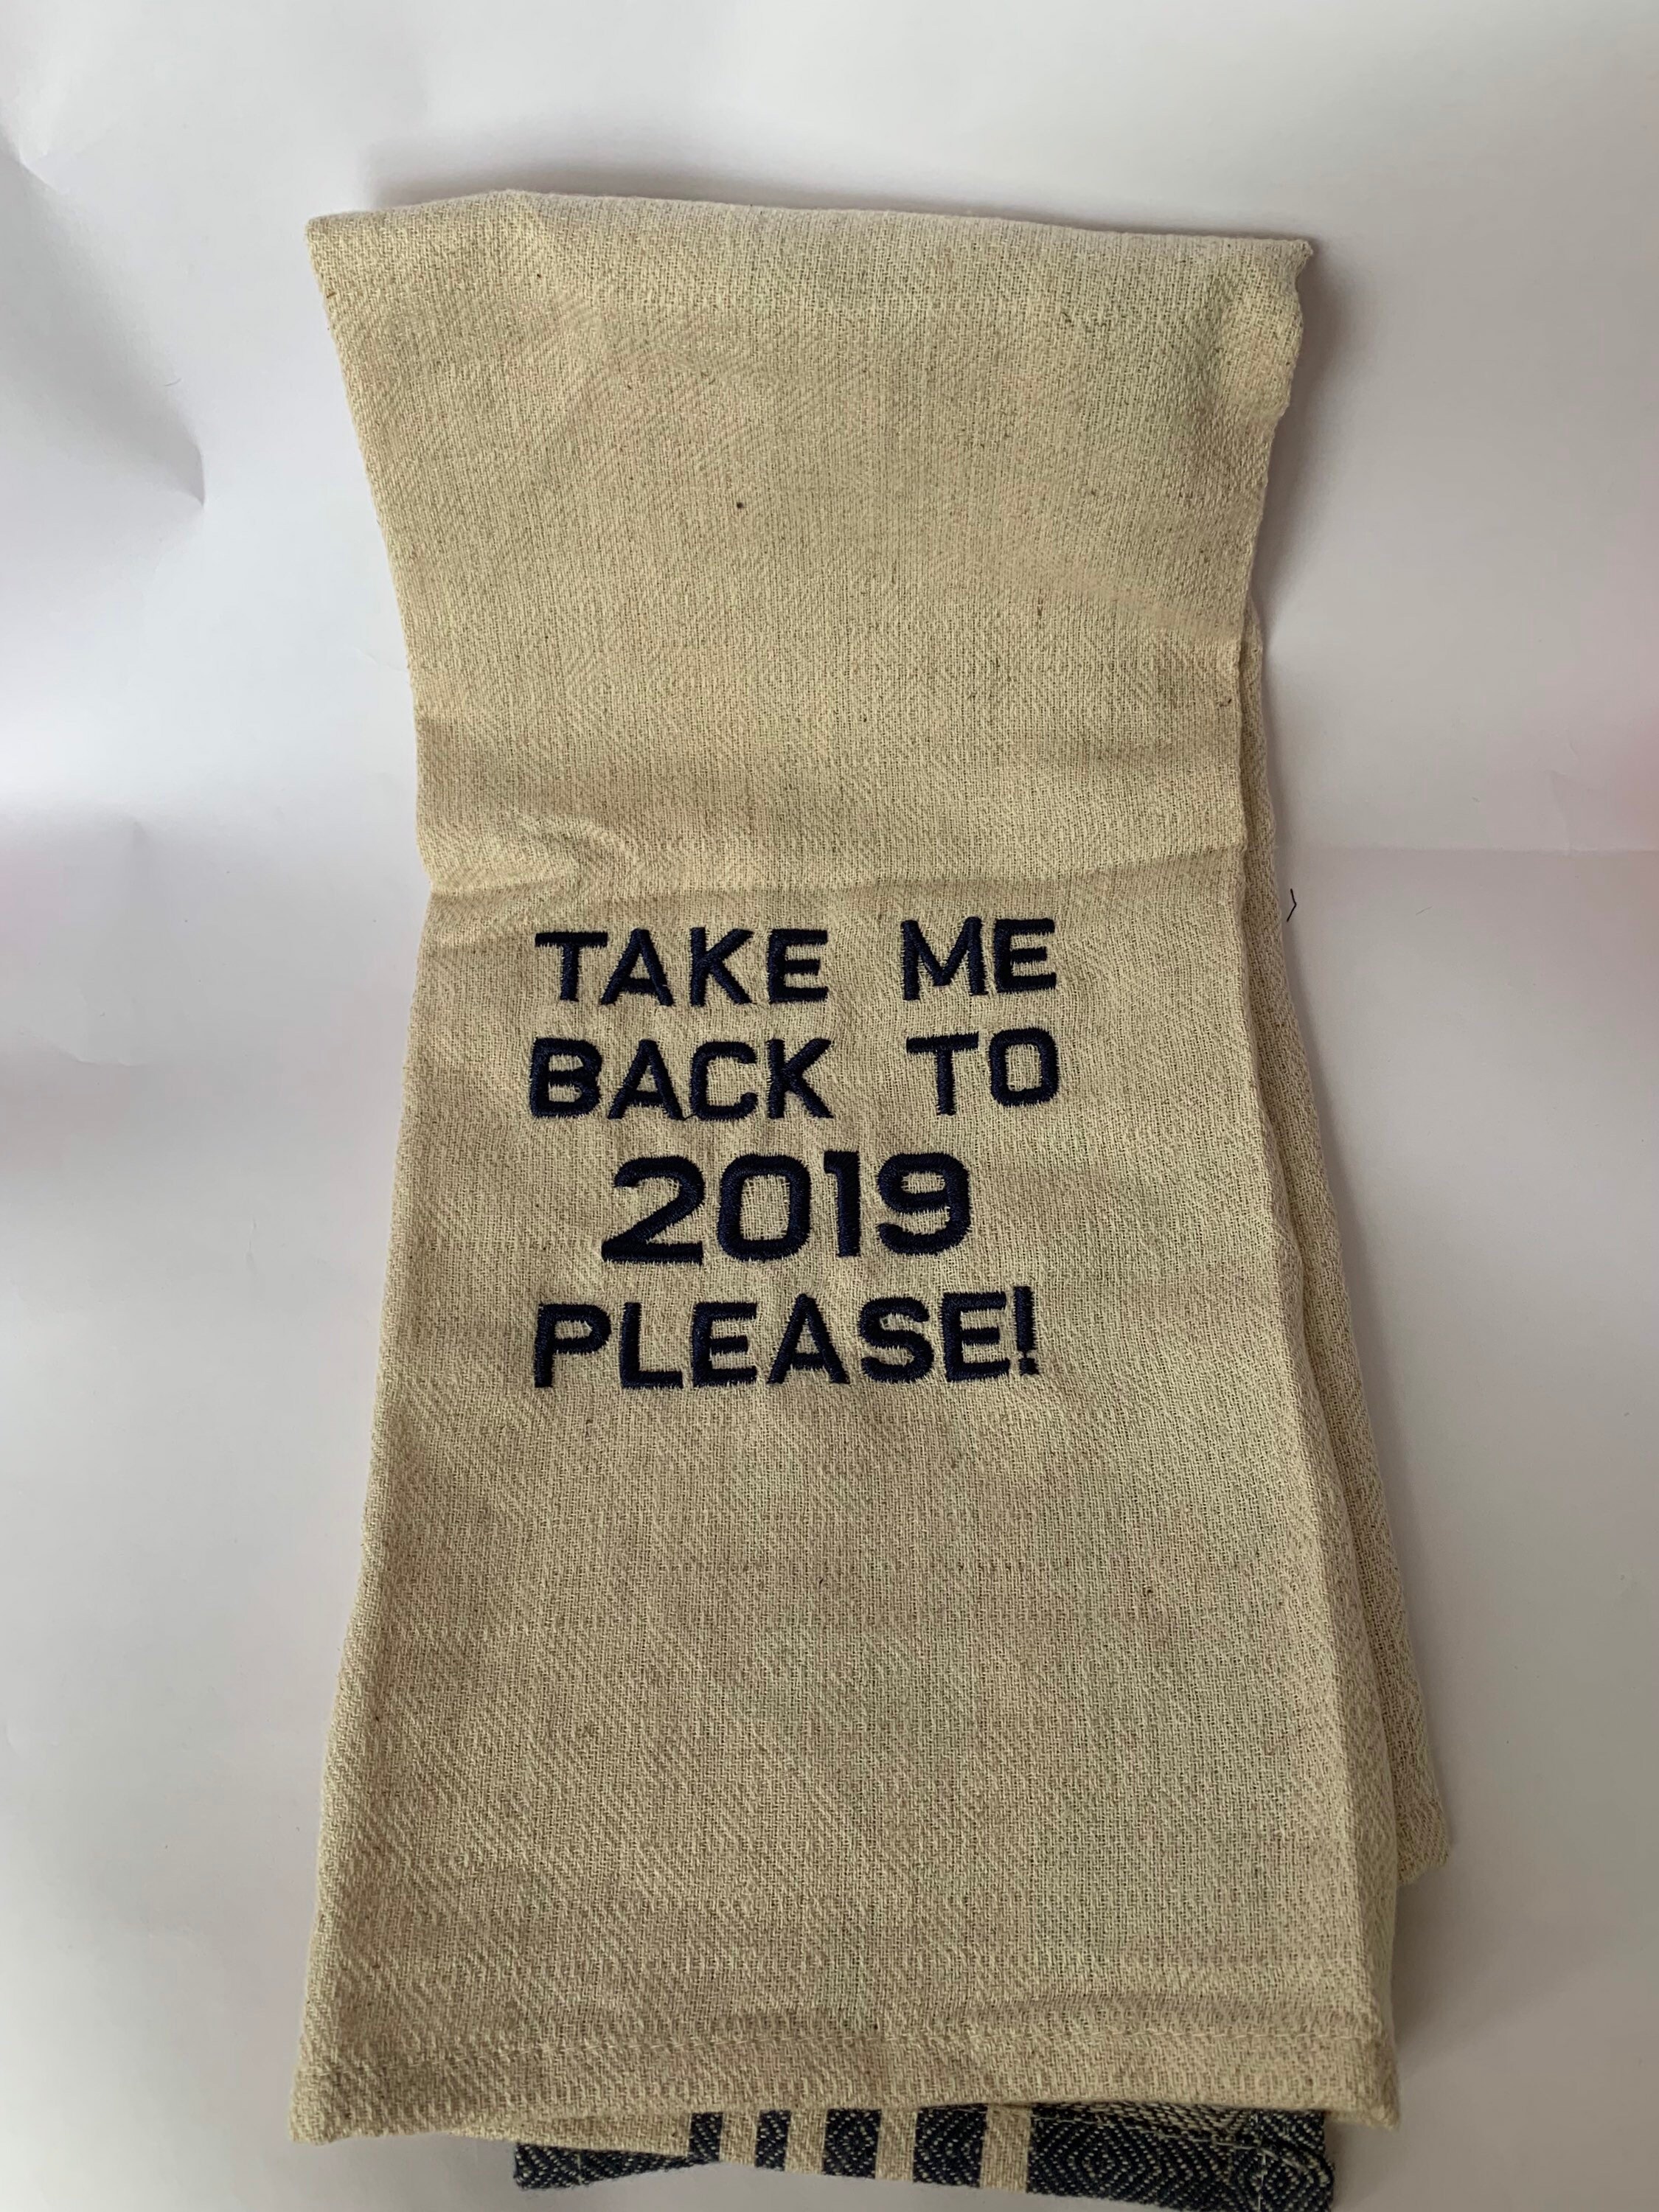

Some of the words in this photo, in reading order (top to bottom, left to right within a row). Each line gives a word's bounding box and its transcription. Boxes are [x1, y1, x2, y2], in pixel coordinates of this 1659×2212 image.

[535, 927, 829, 1007] TAKE
[900, 916, 1057, 1001] ME
[529, 1037, 834, 1121] BACK
[905, 1027, 1060, 1116] TO
[601, 1150, 973, 1266] 2019
[533, 1285, 1040, 1389] PLEASE!
